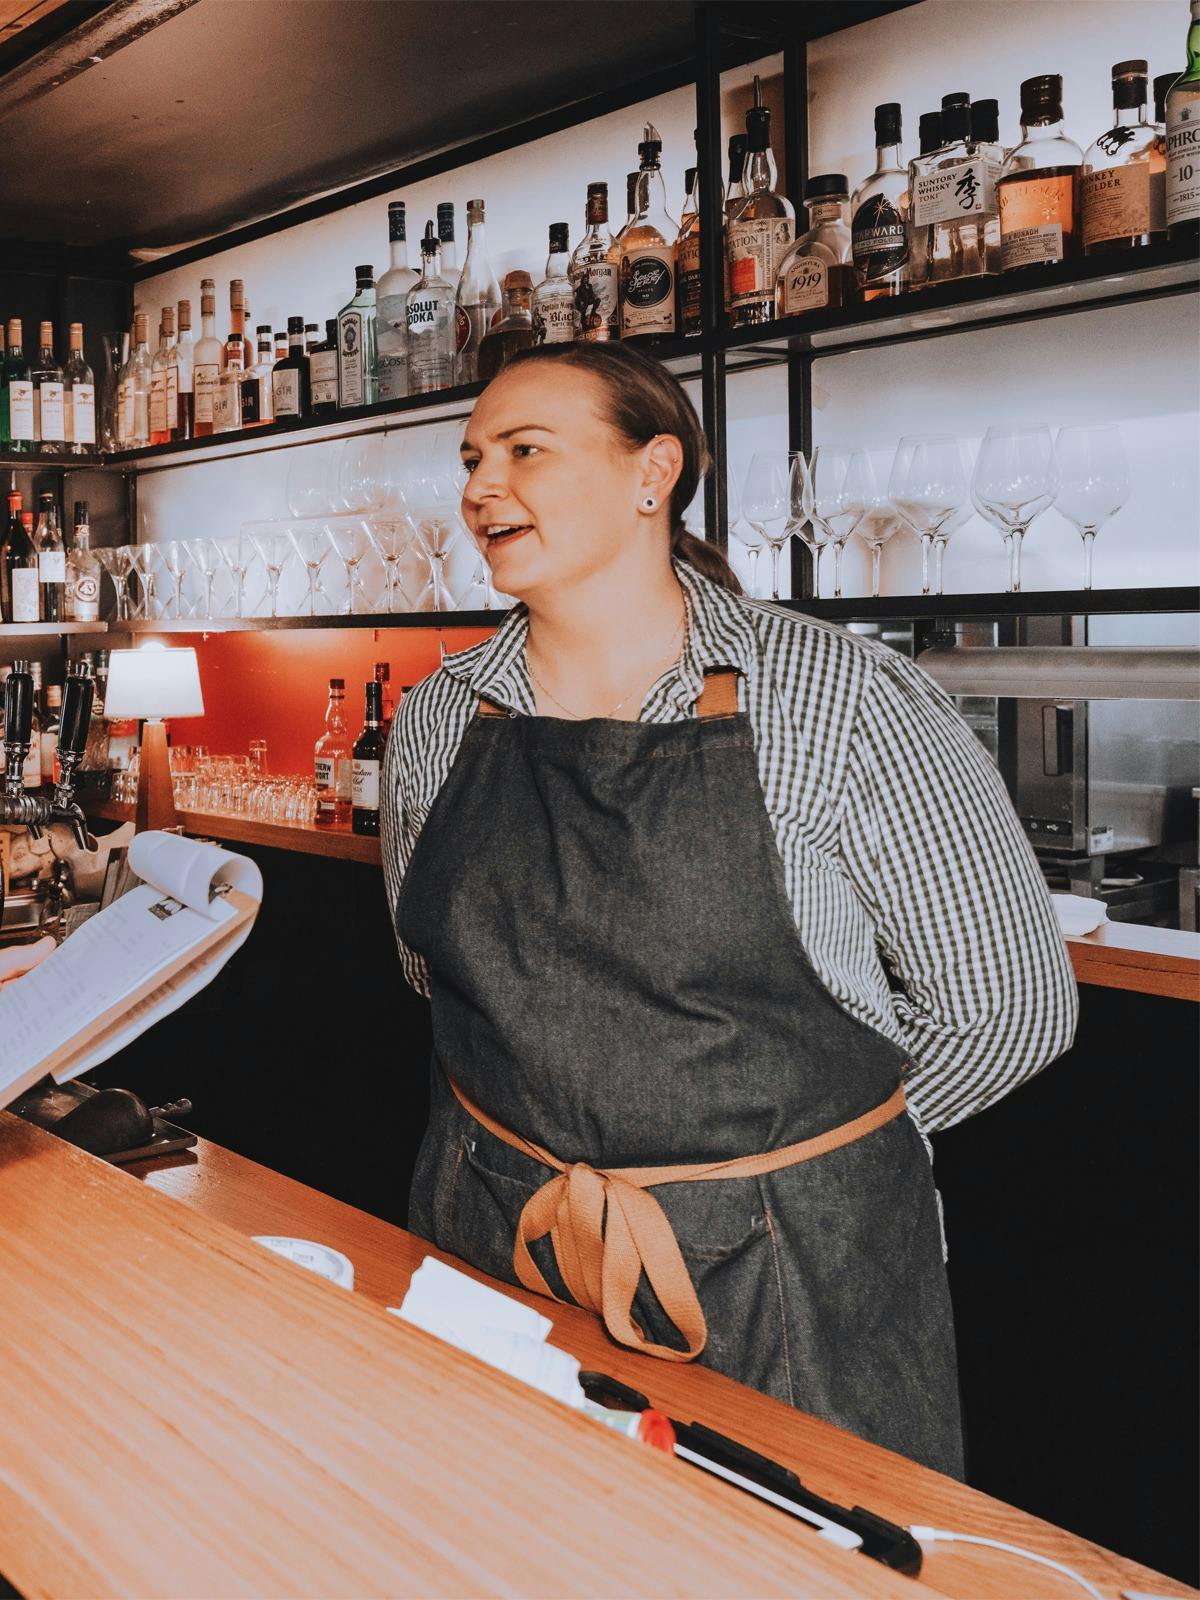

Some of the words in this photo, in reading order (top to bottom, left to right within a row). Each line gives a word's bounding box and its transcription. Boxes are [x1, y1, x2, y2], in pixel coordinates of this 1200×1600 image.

[918, 173, 957, 189] SUNTORY
[1179, 164, 1193, 181] 10
[918, 182, 951, 195] WHISKY
[954, 167, 981, 210] 季
[791, 272, 822, 291] 1919
